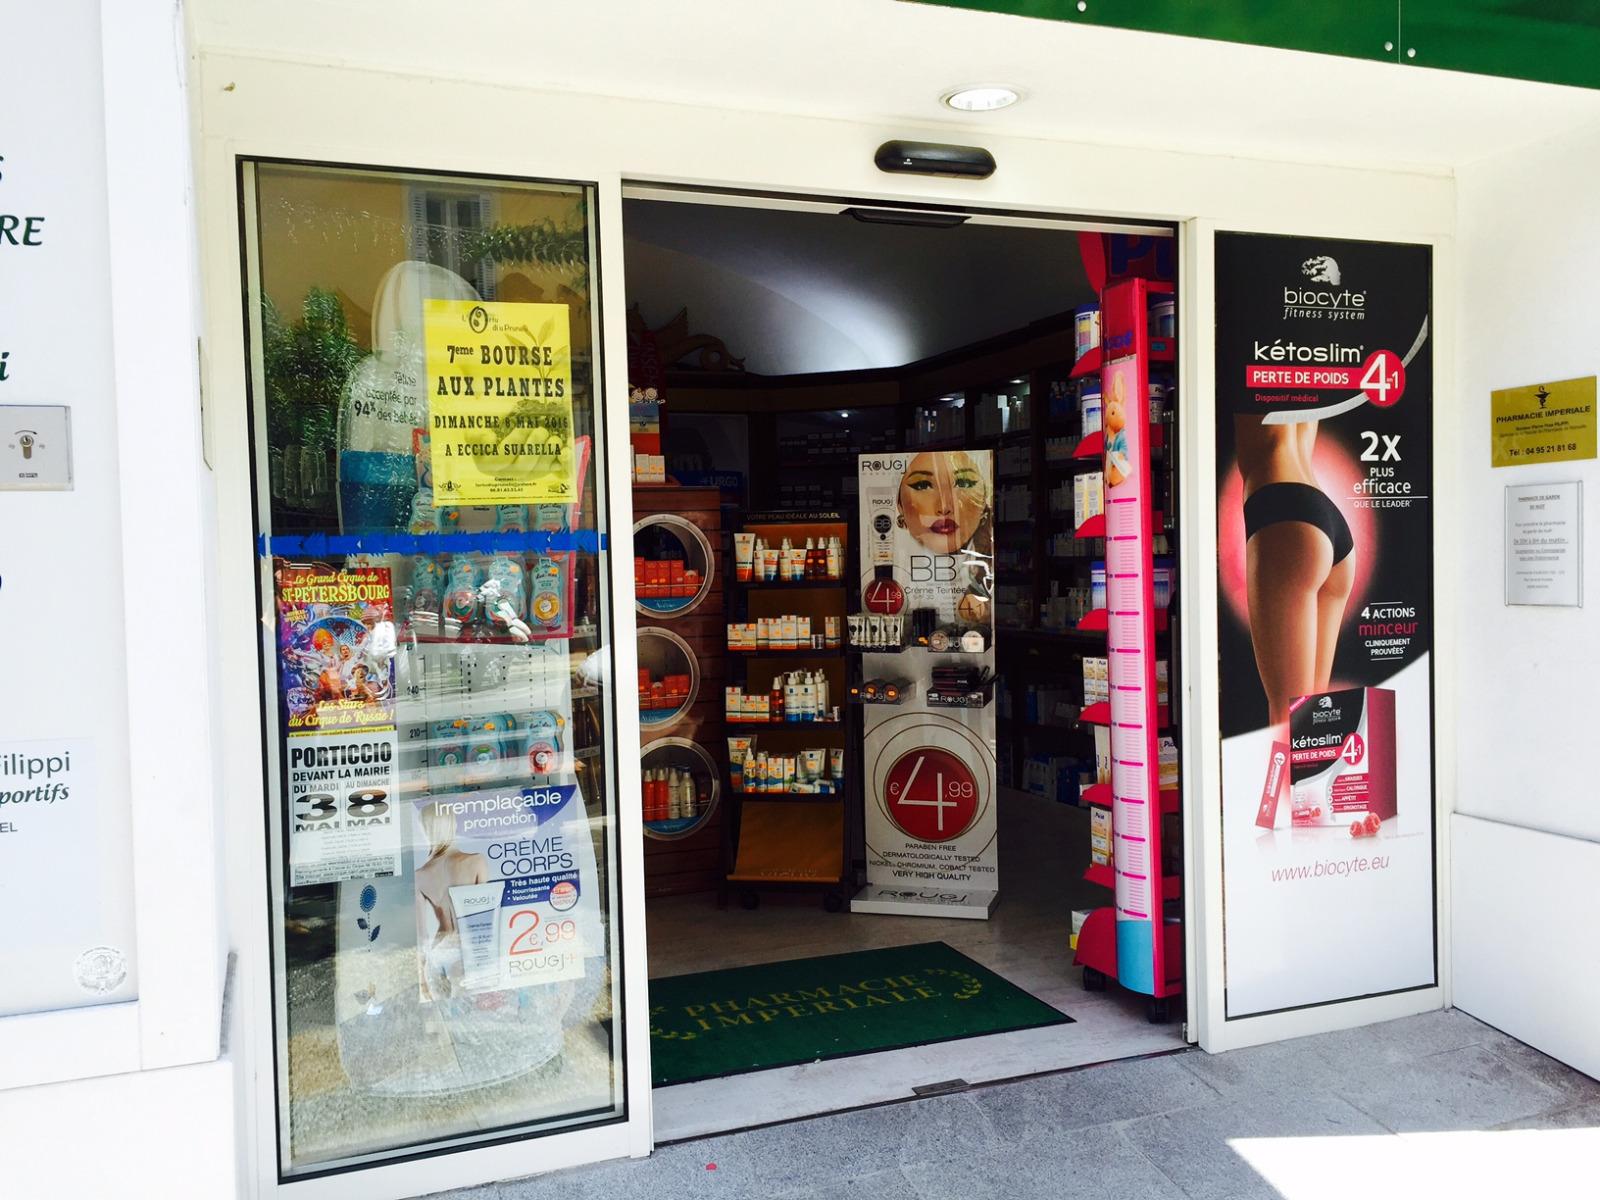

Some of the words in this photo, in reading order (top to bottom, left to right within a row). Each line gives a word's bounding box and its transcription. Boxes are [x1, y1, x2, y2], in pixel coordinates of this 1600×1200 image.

[1283, 287, 1365, 309] biocyte
[1283, 307, 1323, 320] fitness
[1328, 309, 1365, 321] system
[447, 345, 474, 364] 7eme
[481, 345, 552, 367] BOURSE
[1254, 339, 1361, 363] kétoslim
[1253, 370, 1292, 384] PERTE
[1294, 371, 1311, 384] DE
[1313, 372, 1349, 385] POIDS
[437, 376, 475, 396] AUX
[483, 378, 564, 398] PLANTES
[1255, 393, 1289, 403] Dispositif
[1290, 394, 1319, 402] médical
[434, 415, 500, 429] DIMANCHE
[504, 415, 511, 429] 8
[516, 415, 539, 429] MAI
[544, 415, 569, 429] 2016
[1496, 411, 1543, 424] PHARMACIE
[1545, 405, 1591, 418] IMPERIALE
[445, 444, 453, 457] A
[457, 444, 499, 457] ECCICA
[504, 443, 562, 456] SUARELLA
[1369, 467, 1395, 478] PLUS
[1353, 478, 1412, 495] efficace
[1353, 500, 1369, 508] QUE
[1370, 500, 1380, 508] LE
[910, 555, 957, 582] BB
[306, 572, 337, 586] Grand
[337, 571, 367, 587] Cirque
[366, 573, 379, 582] de
[282, 585, 390, 603] ST-PETERSBOURG
[904, 586, 934, 594] Crème
[1361, 607, 1371, 619] 4
[1373, 607, 1416, 619] ACTIONS
[1359, 621, 1419, 637] minceur
[1364, 638, 1411, 648] CLINIQUEMENT
[304, 712, 338, 729] Cirque
[1292, 733, 1342, 749] kétoslim
[291, 742, 392, 769] PORTICCIO
[1292, 752, 1309, 761] PERTE
[1310, 751, 1318, 759] DE
[1318, 749, 1336, 758] POIDS
[0, 751, 71, 779] ilippi
[292, 771, 335, 782] DEVANT
[338, 770, 351, 779] LA
[354, 766, 390, 777] MAIRIE
[293, 785, 307, 793] DU
[309, 782, 339, 792] MARDI
[346, 781, 356, 789] AU
[356, 778, 390, 788] DIMANCHE
[295, 793, 338, 822] 3
[347, 789, 390, 818] 8
[435, 791, 562, 817] Irremplaçable
[295, 823, 340, 833] MAI
[347, 816, 390, 827] MAI
[463, 812, 537, 832] promotion
[487, 836, 564, 860] CRÈME
[905, 843, 937, 851] PARABEN
[501, 852, 574, 876] CORPS
[882, 851, 952, 861] DERMATOLOGICALLY
[1271, 855, 1390, 882] www.biocyte.eu
[510, 879, 527, 887] Très
[529, 876, 550, 885] haute
[551, 872, 578, 883] qualité
[937, 873, 971, 881] QUALITY
[683, 974, 927, 1018] PHARMACIE
[693, 985, 942, 1032] IMPERIALE
